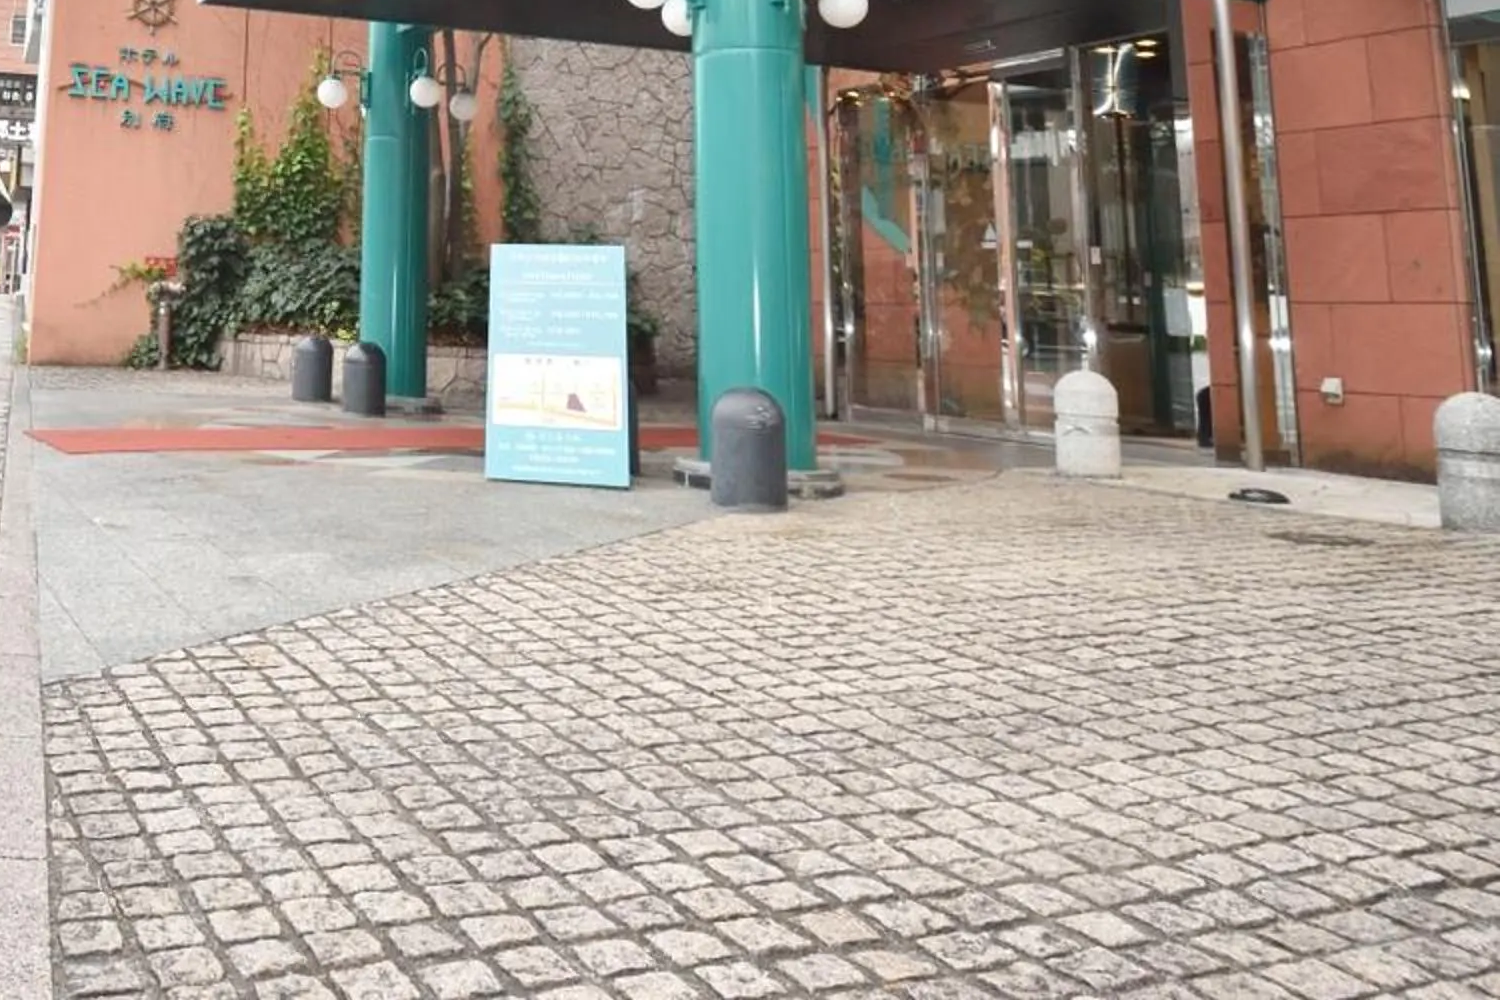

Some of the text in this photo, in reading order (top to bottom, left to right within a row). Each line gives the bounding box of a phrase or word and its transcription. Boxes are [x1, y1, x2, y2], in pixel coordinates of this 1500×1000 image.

[118, 47, 180, 68] ホテル
[67, 62, 228, 111] SEA WAVE
